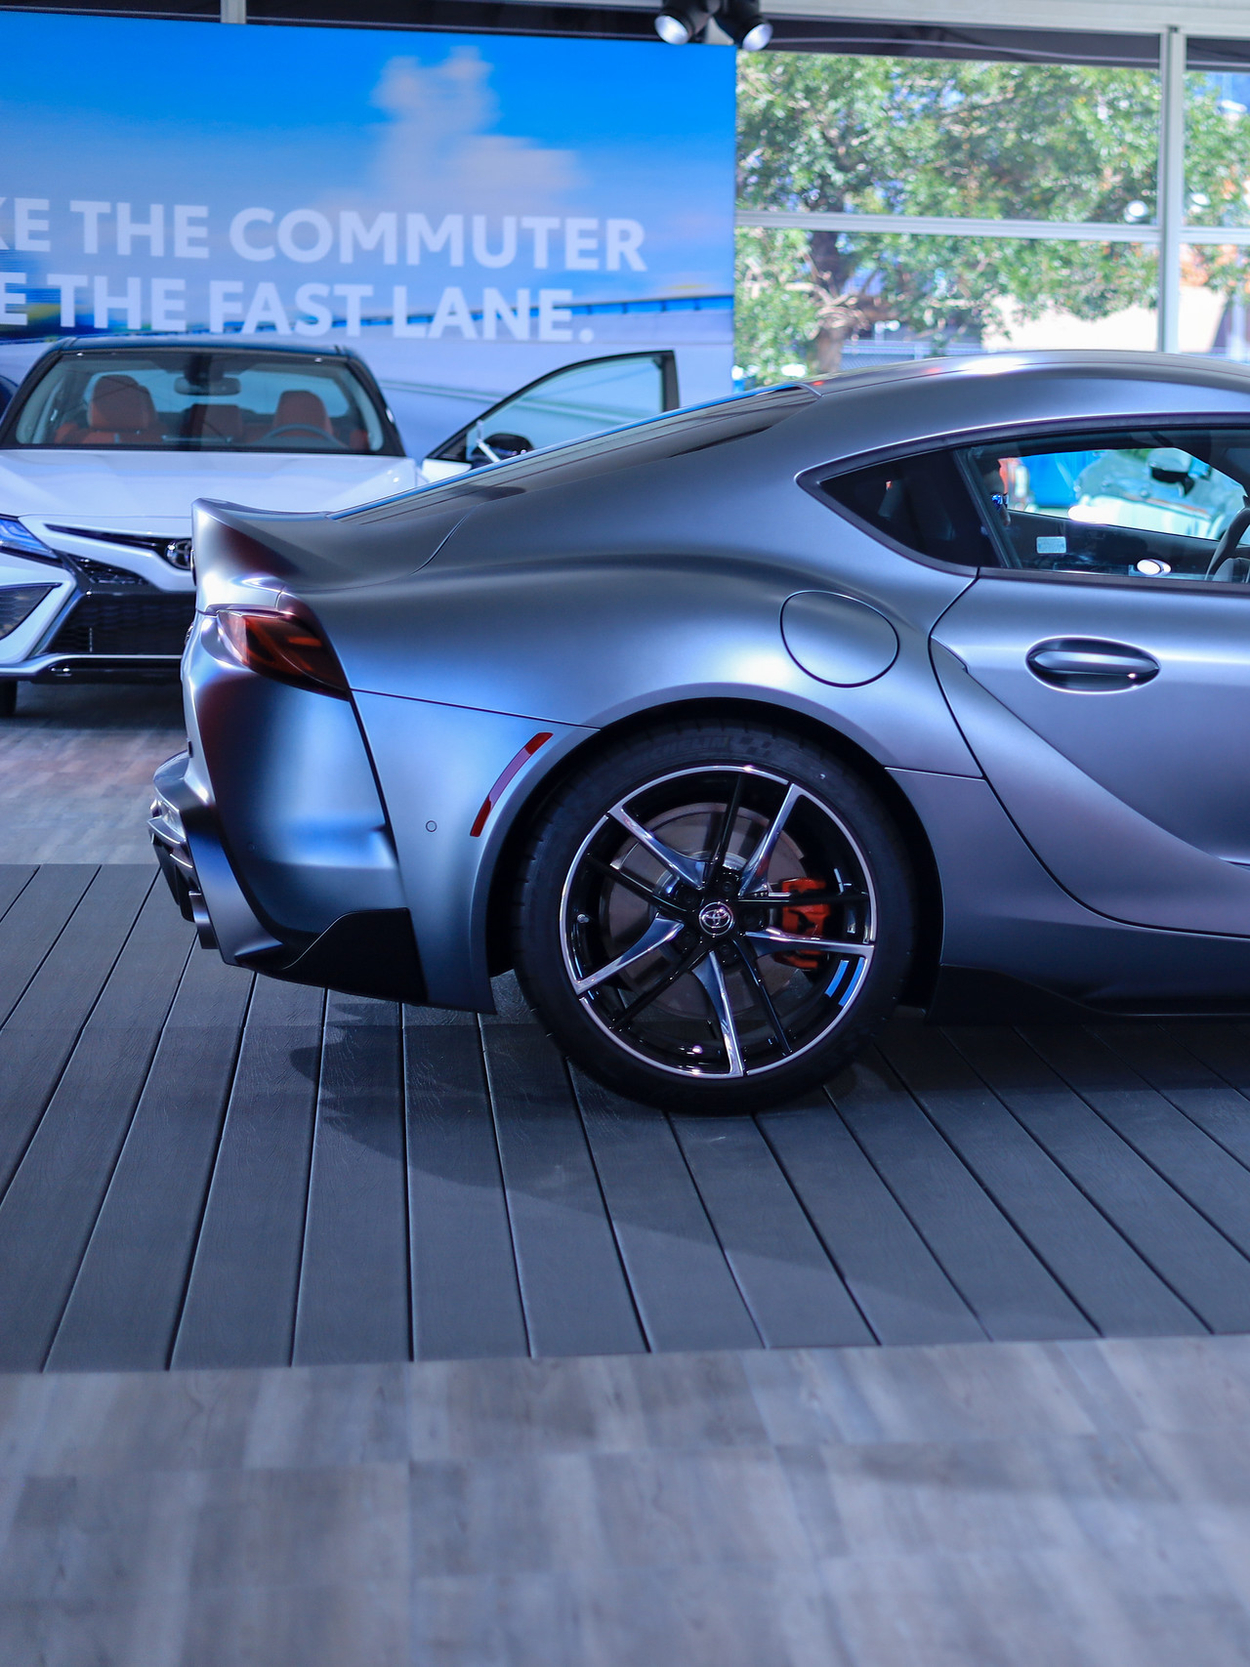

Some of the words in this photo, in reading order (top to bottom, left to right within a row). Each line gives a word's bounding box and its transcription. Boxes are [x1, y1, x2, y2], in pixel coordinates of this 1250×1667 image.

[70, 200, 210, 258] THE
[228, 207, 648, 272] COMMUTER
[47, 272, 187, 332] THE
[208, 280, 374, 337] FAST
[392, 285, 595, 344] LANE.
